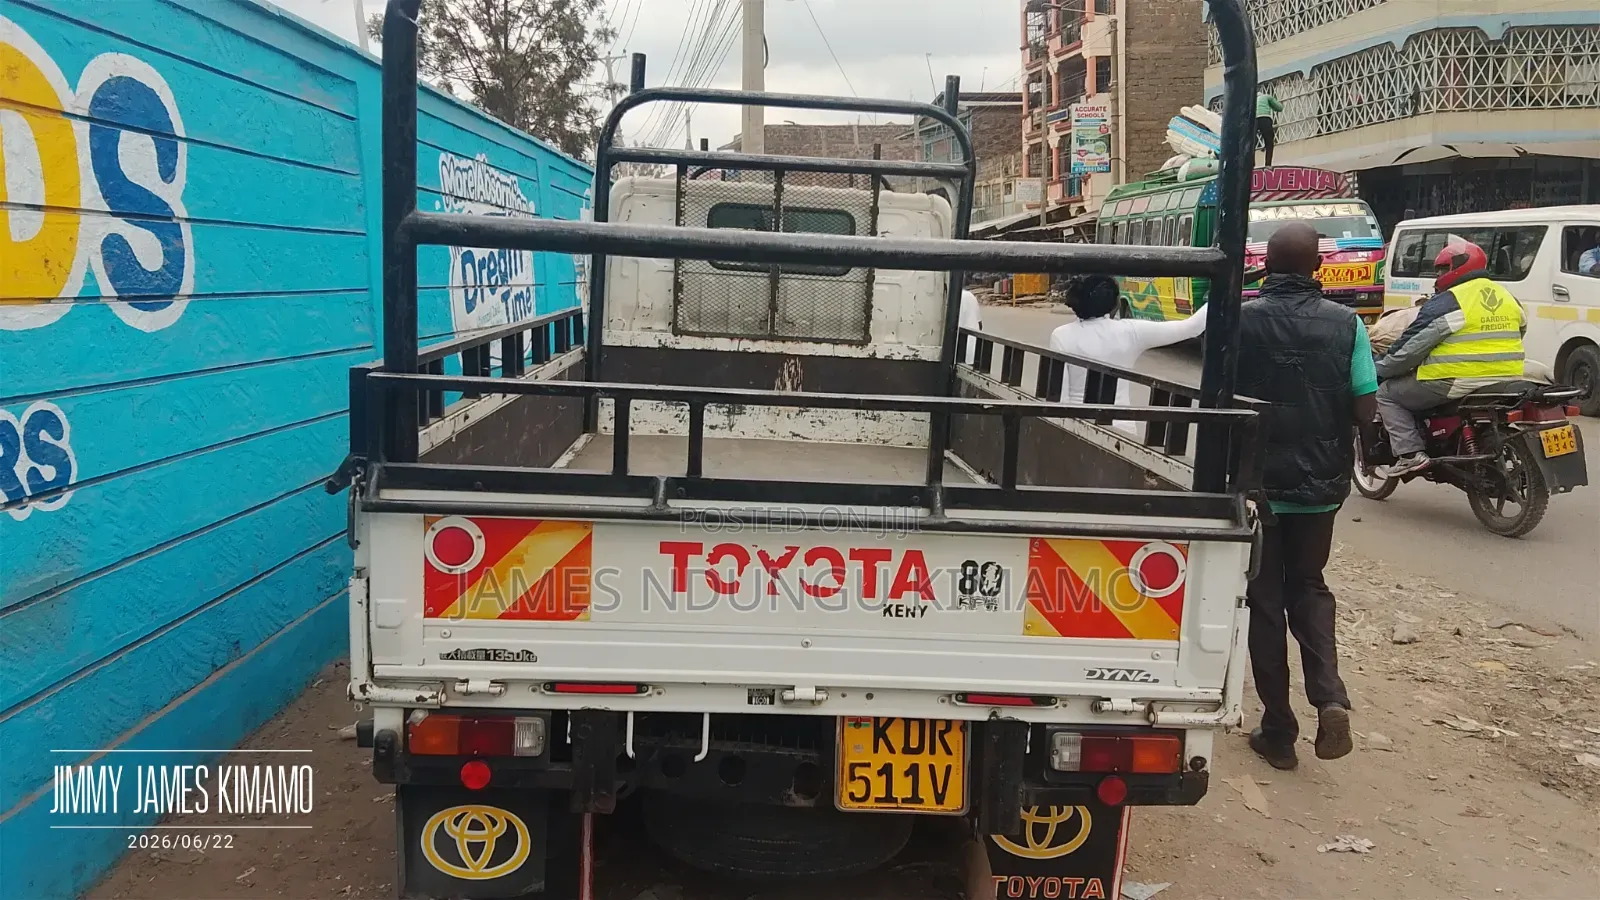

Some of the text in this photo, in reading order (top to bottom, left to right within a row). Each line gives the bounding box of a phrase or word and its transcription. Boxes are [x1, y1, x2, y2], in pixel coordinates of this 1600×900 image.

[441, 156, 474, 208] More
[1249, 204, 1367, 221] MARVEL
[501, 287, 532, 324] Time
[1480, 315, 1510, 324] GARDEN
[1480, 322, 1511, 331] FREIGHT
[660, 541, 936, 601] TOYOTA
[959, 560, 1003, 597] 80
[1084, 668, 1155, 683] DYNA
[873, 717, 953, 756] KDR
[848, 762, 953, 806] 511V
[991, 875, 1106, 899] TOYOTA
